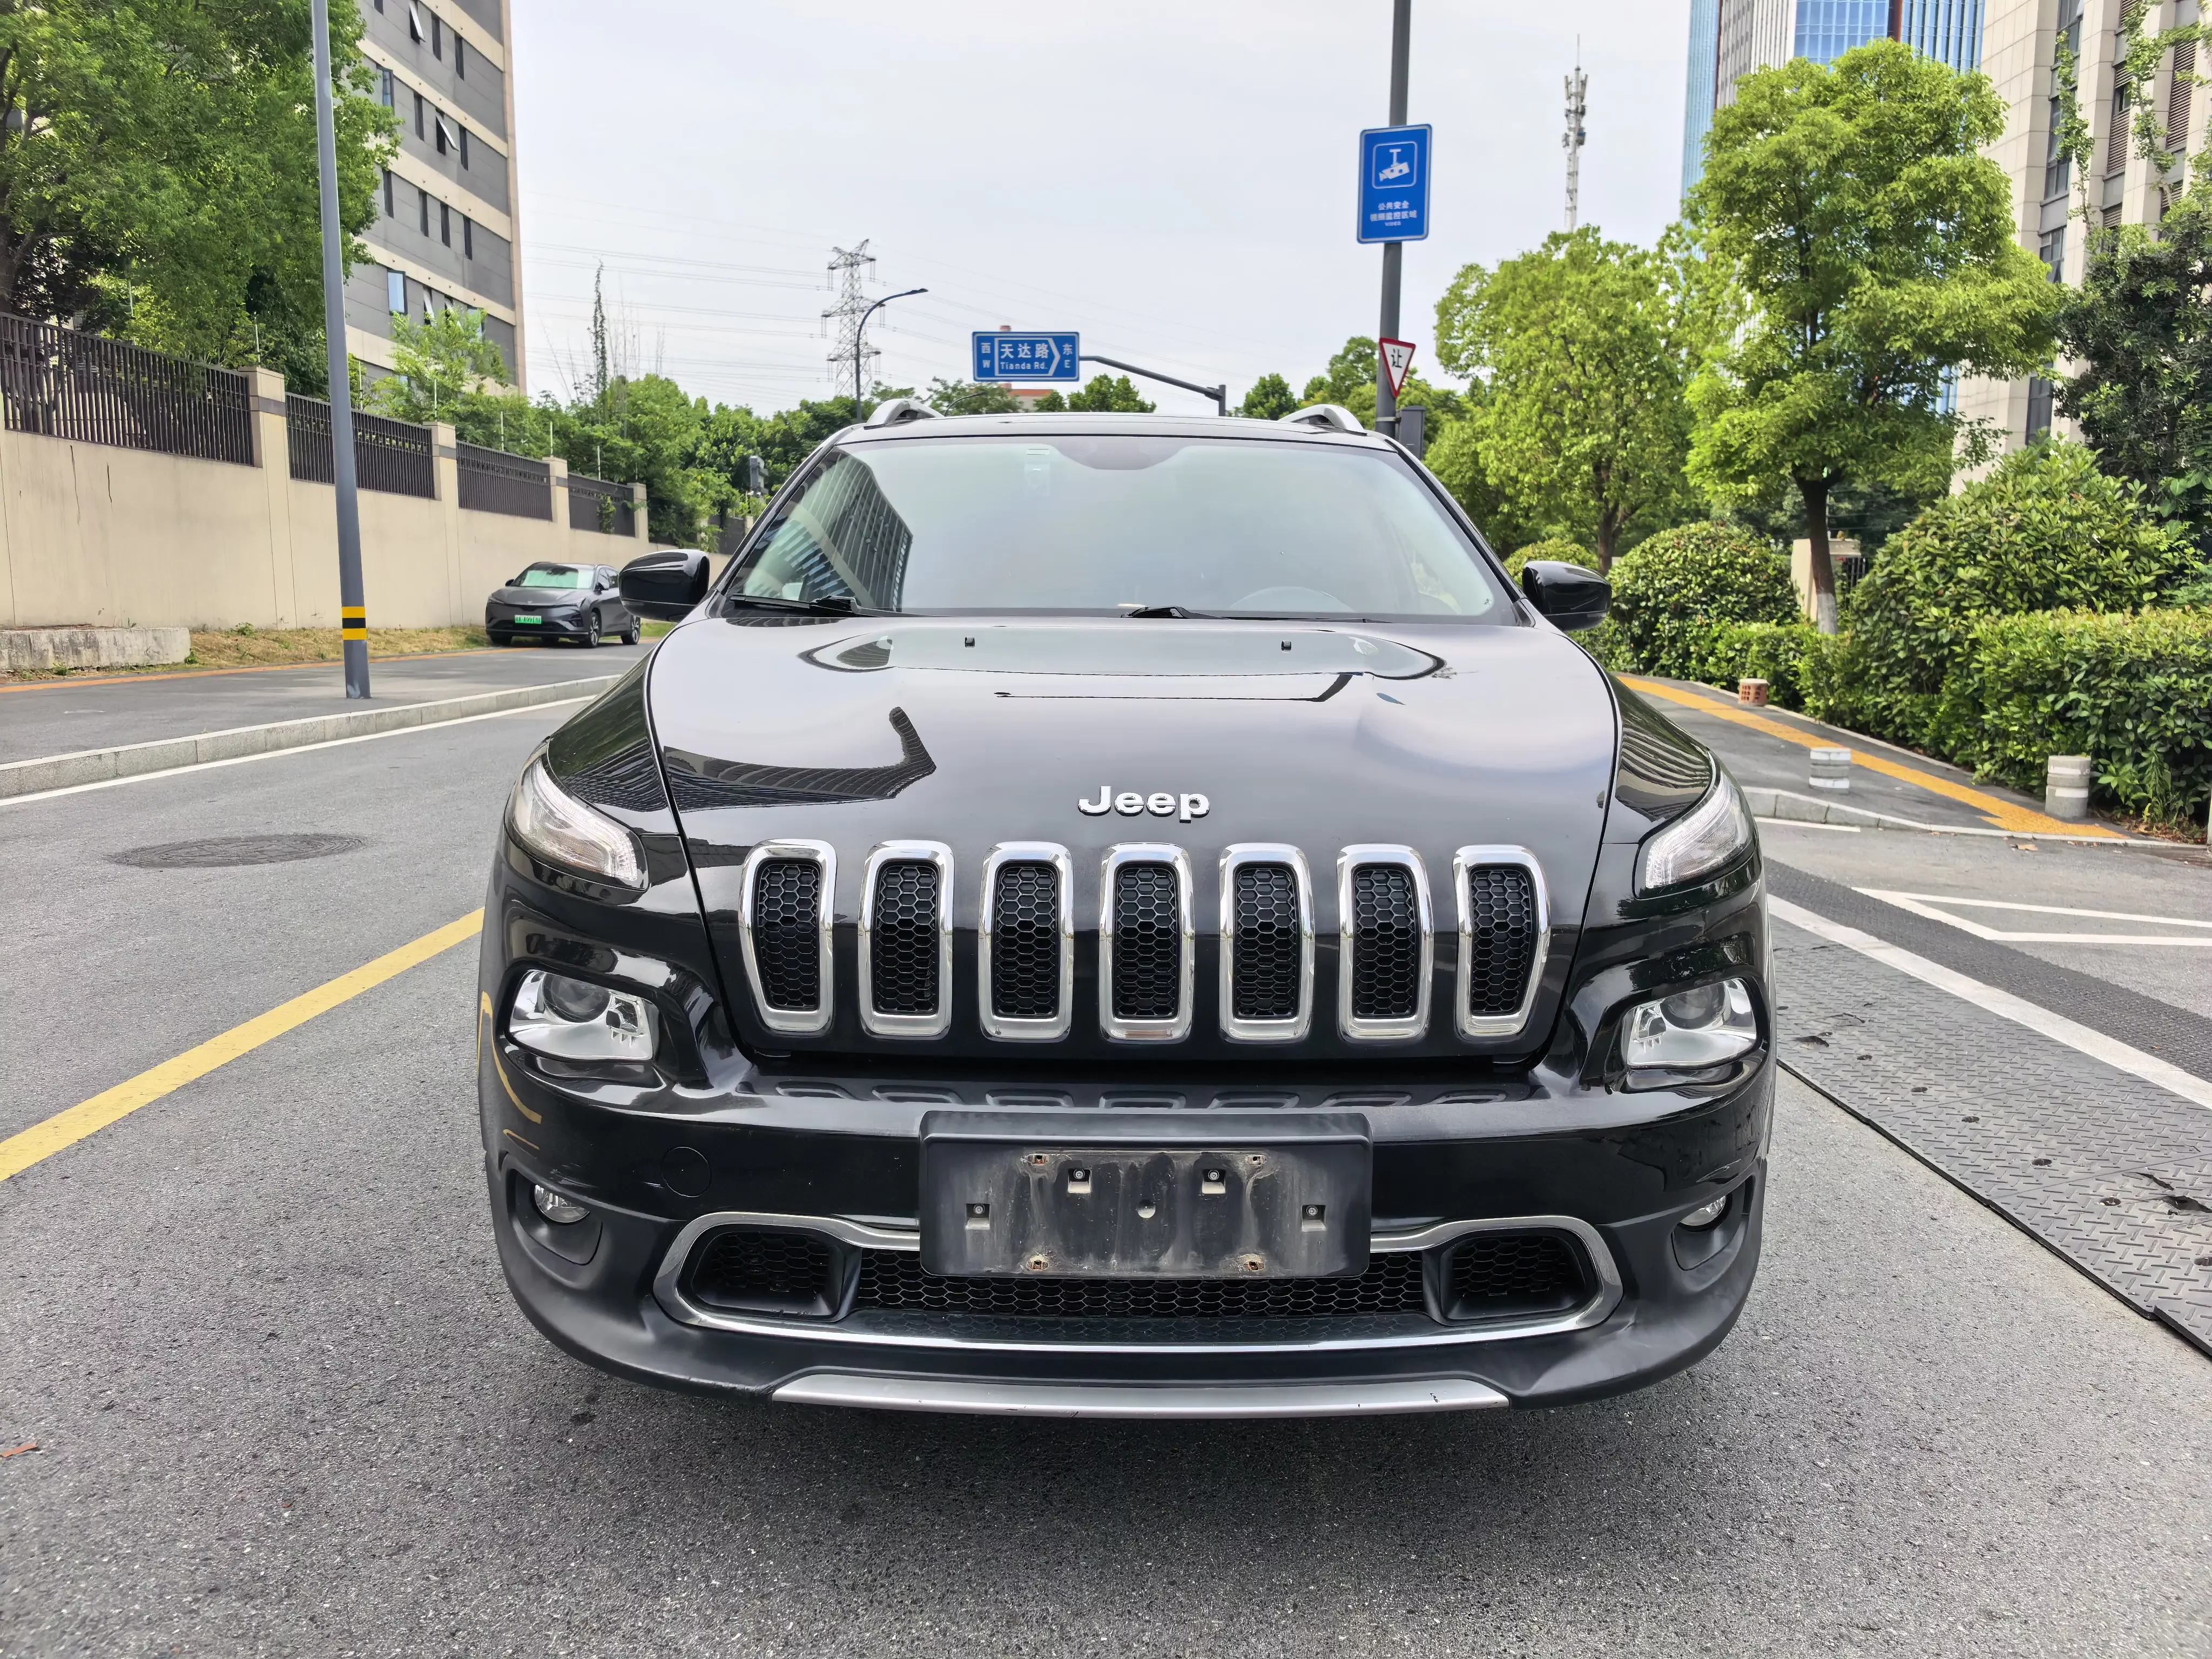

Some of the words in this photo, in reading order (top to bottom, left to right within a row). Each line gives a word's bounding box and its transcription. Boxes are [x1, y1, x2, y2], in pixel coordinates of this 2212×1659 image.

[981, 342, 991, 354] 西
[1000, 343, 1049, 359] 天达路
[1062, 343, 1073, 355] 东
[982, 360, 991, 368] W
[1064, 360, 1071, 368] E
[1391, 348, 1402, 368] 让
[1077, 786, 1210, 824] Jeep
